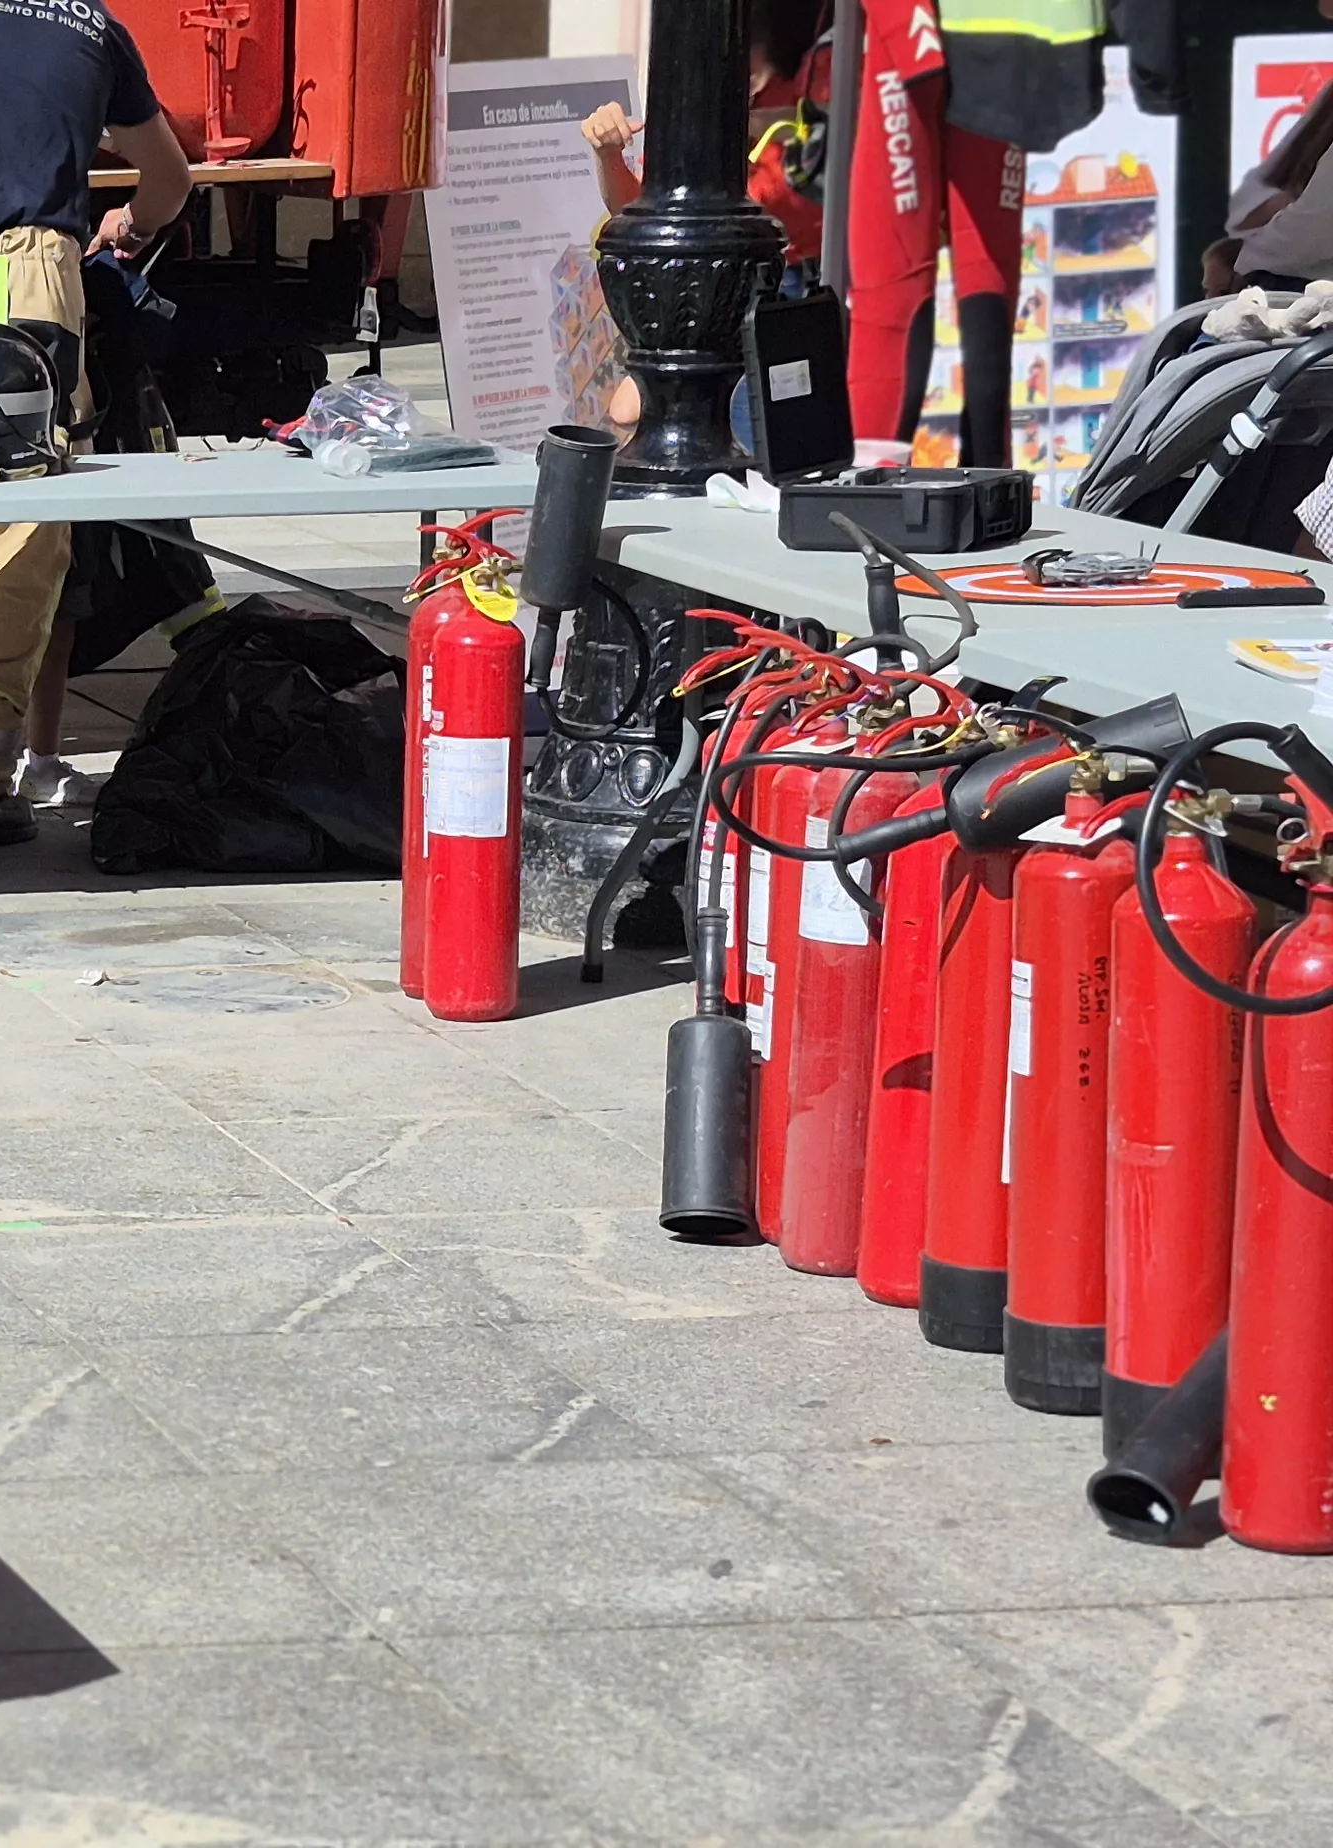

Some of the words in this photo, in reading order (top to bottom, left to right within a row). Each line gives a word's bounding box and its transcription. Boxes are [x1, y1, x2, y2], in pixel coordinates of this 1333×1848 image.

[36, 10, 55, 21] DE
[58, 15, 105, 46] HUESCA
[483, 106, 496, 126] En
[496, 108, 517, 124] caso
[518, 103, 530, 123] de
[875, 70, 919, 215] RESCATE
[998, 142, 1025, 210] RES
